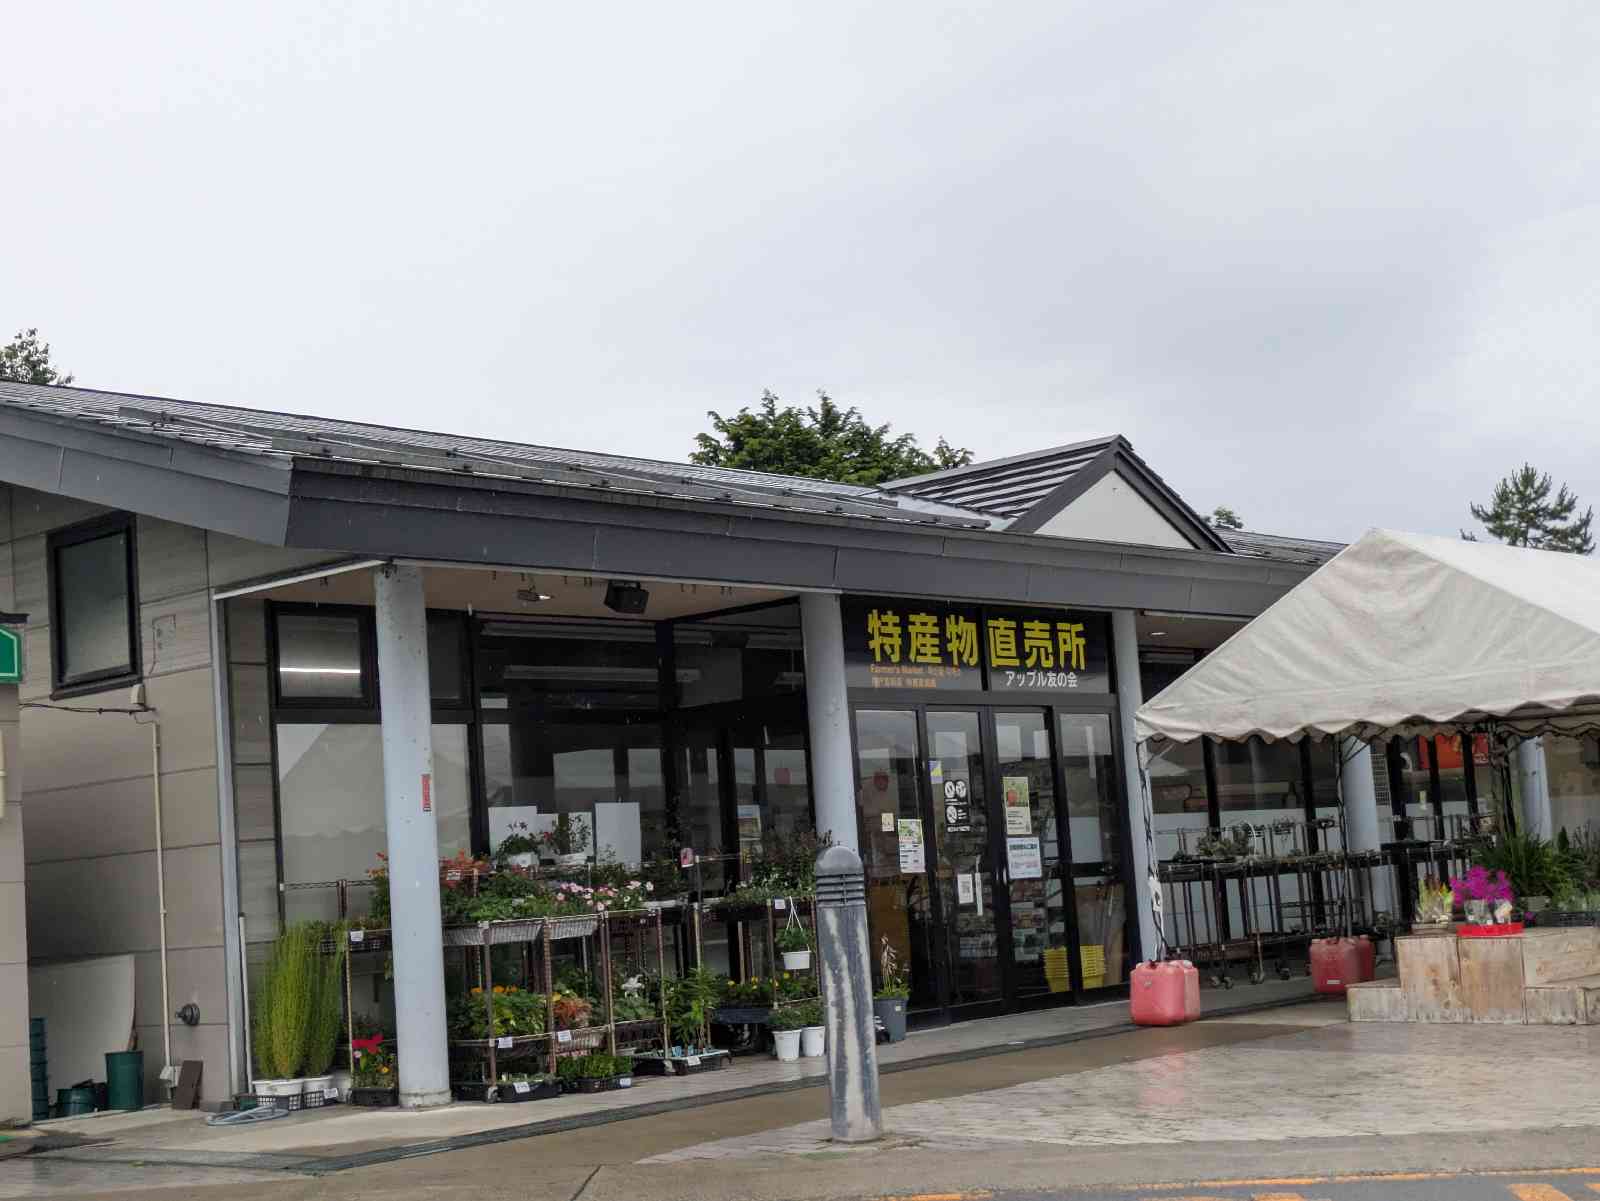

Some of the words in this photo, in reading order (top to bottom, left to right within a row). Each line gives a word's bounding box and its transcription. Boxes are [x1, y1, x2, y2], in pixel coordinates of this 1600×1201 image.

[867, 608, 1086, 670] 特産物直売所
[1005, 670, 1078, 688] アップル友の会
